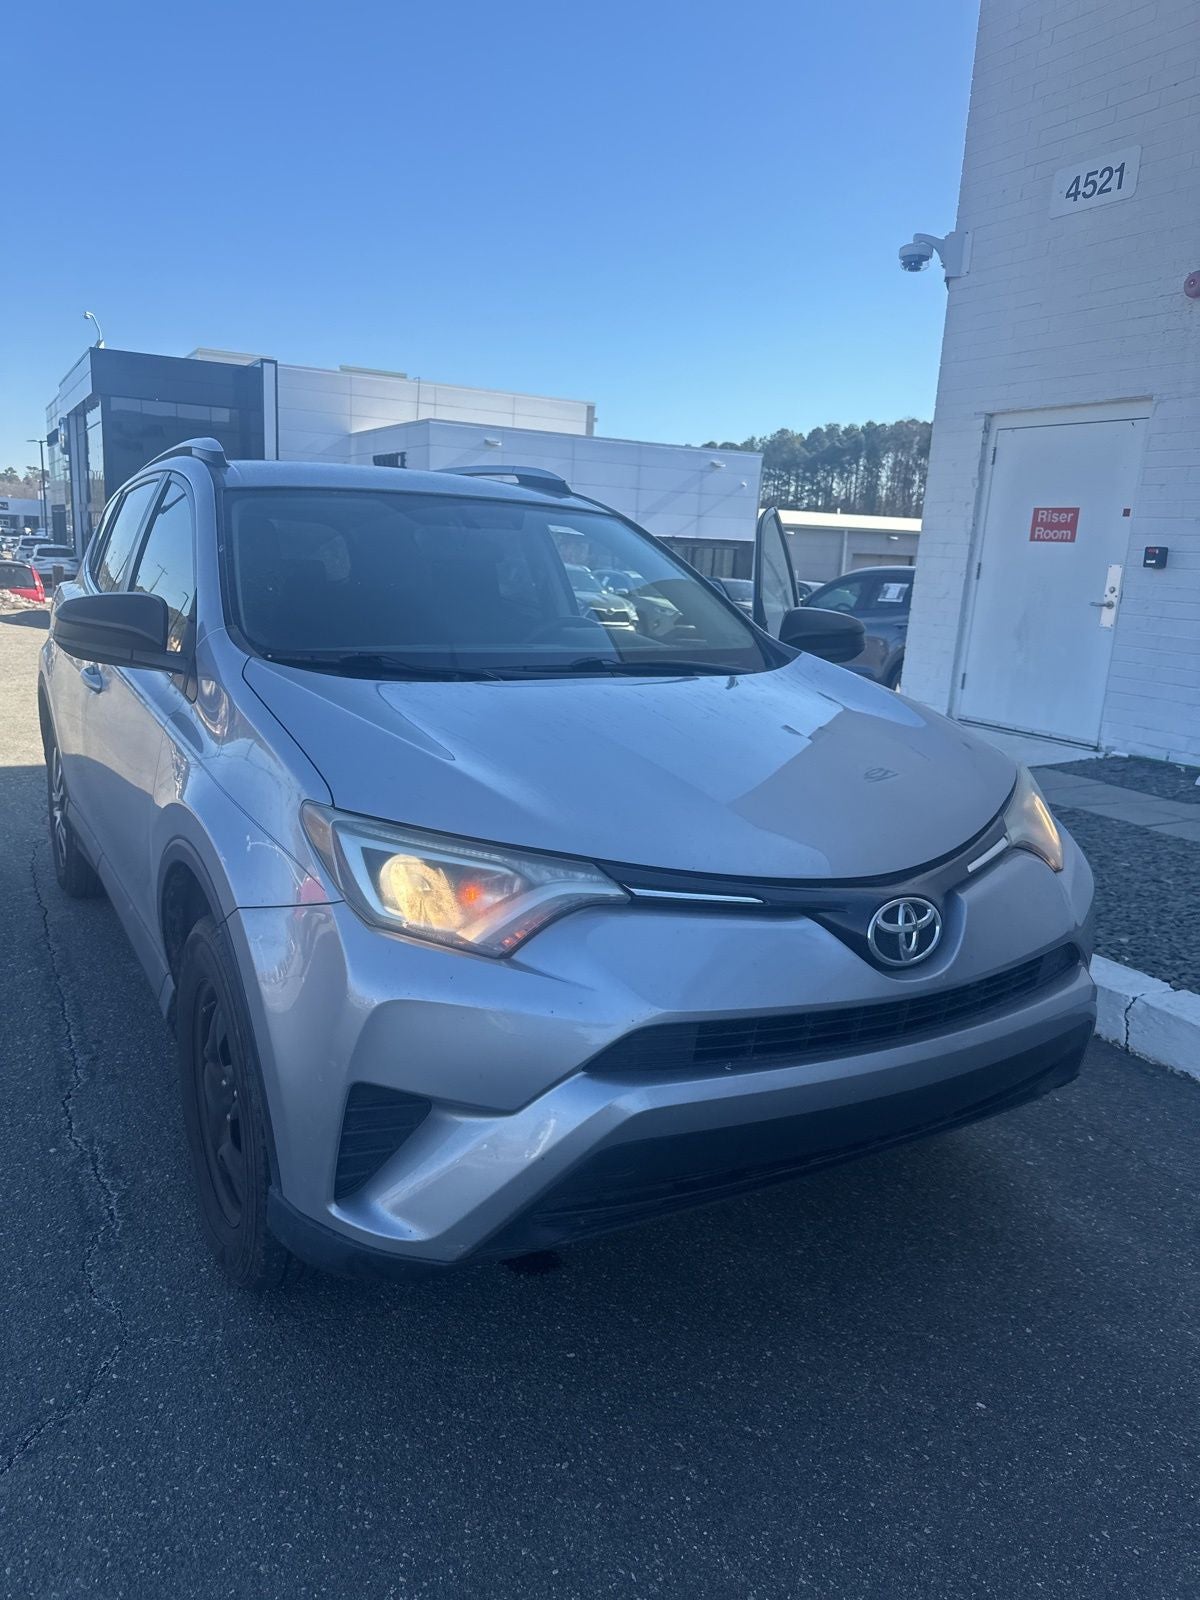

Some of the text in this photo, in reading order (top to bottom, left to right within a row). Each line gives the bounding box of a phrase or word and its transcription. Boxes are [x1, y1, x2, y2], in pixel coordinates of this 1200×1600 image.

[1065, 162, 1126, 202] 4521
[1037, 510, 1074, 523] Riser
[1034, 527, 1072, 540] Room
